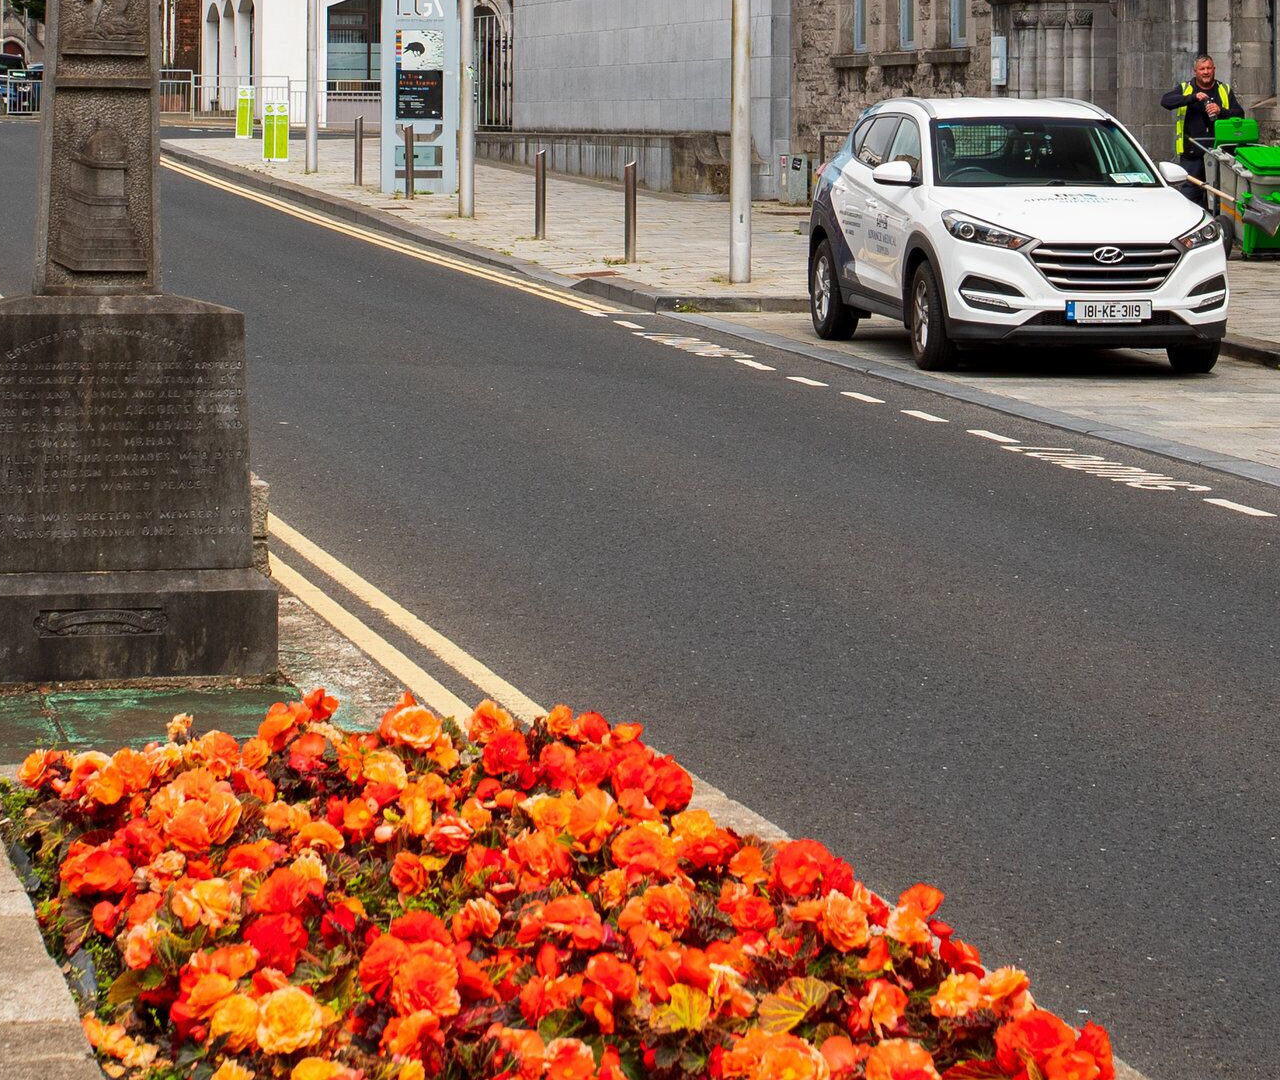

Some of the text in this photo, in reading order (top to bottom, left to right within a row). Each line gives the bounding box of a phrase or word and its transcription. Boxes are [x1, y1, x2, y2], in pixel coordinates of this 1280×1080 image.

[1084, 304, 1141, 318] 181-KE-3119
[44, 453, 70, 465] FOR
[105, 452, 171, 462] COMRADES
[0, 483, 59, 494] SERVICE
[70, 482, 88, 493] OF
[76, 511, 132, 521] ERECTED
